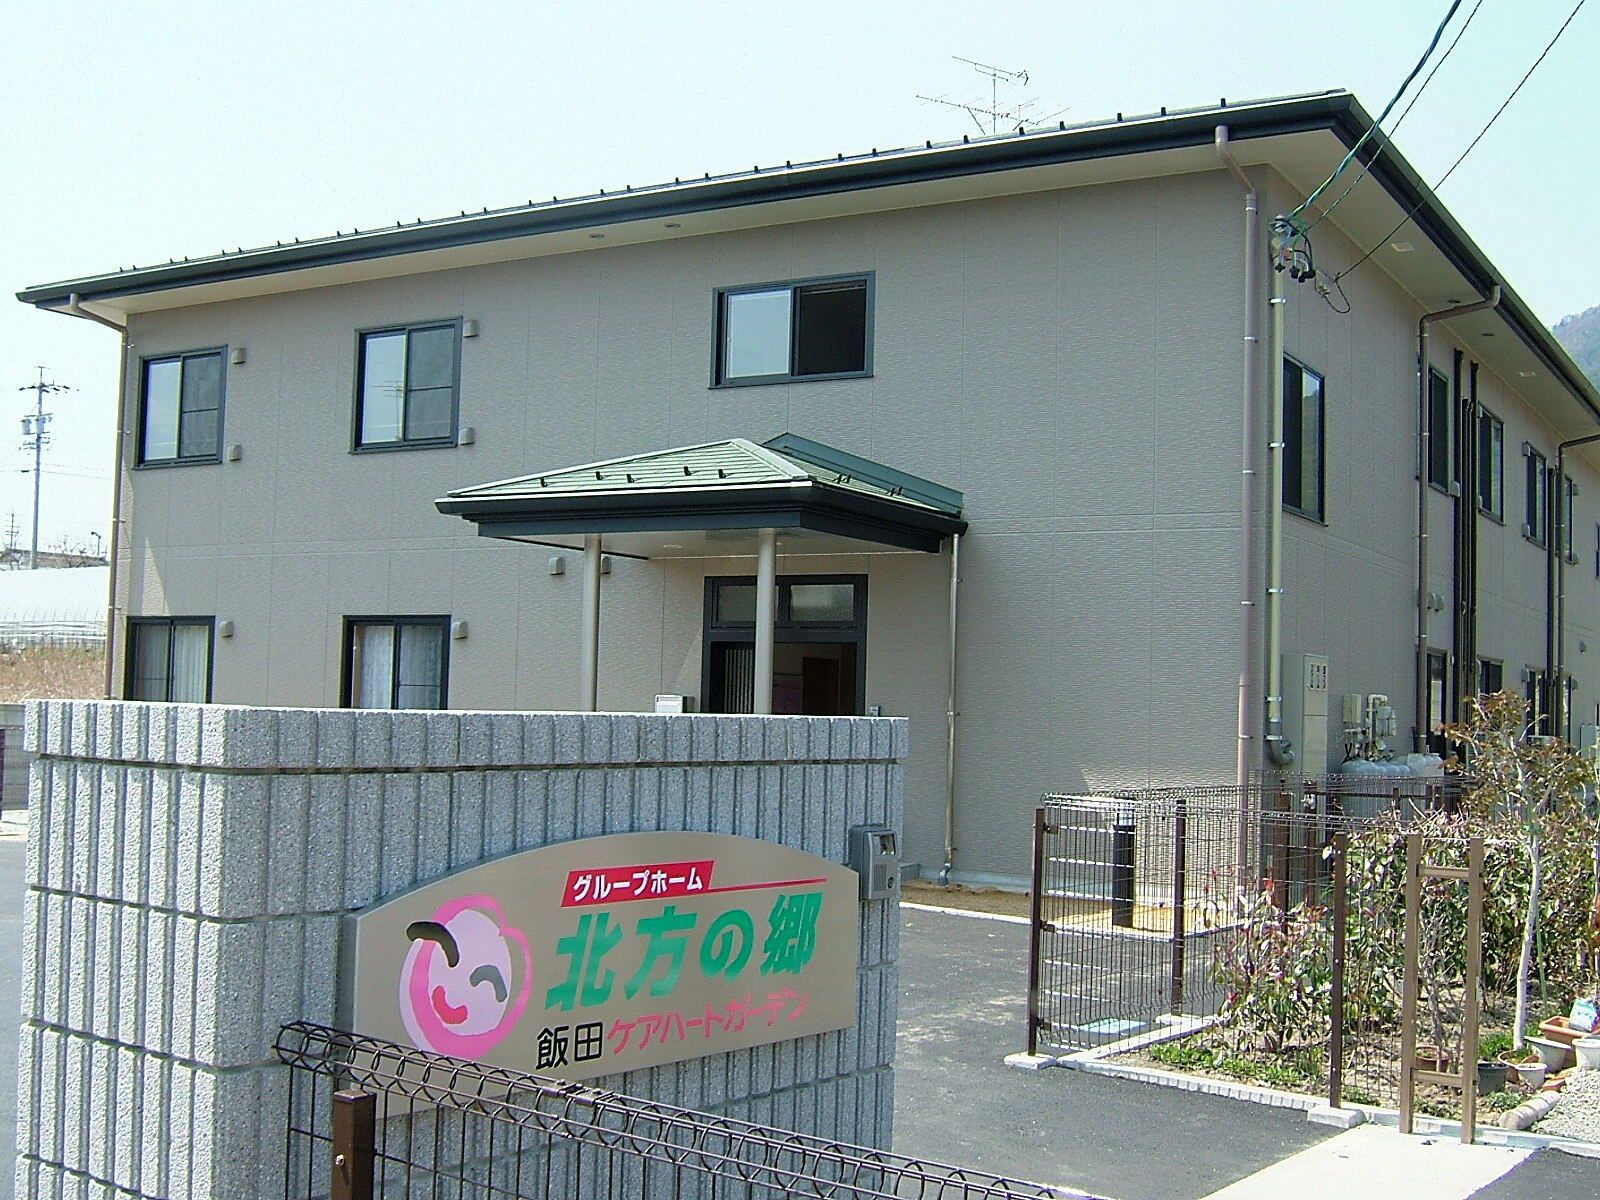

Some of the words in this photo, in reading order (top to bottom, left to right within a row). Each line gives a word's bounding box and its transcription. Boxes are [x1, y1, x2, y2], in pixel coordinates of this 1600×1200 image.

[573, 867, 703, 902] グループホーム
[544, 892, 824, 1012] 北方の郷
